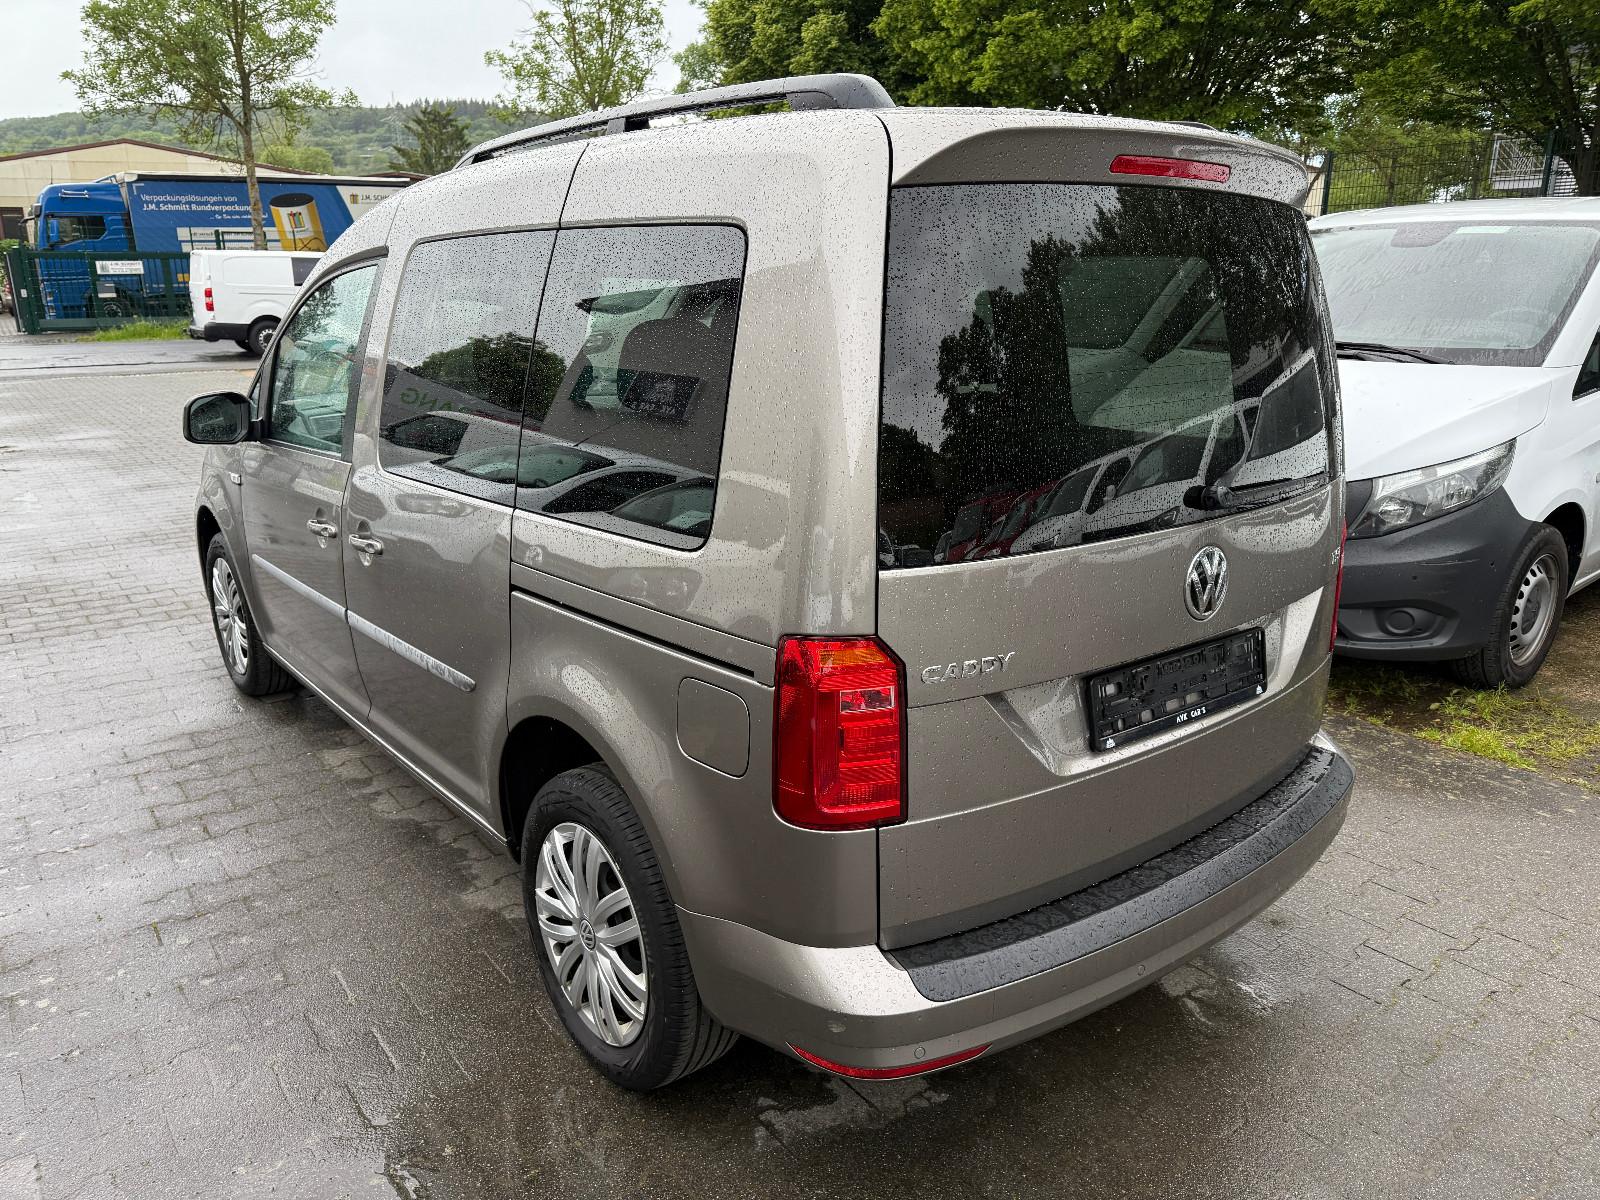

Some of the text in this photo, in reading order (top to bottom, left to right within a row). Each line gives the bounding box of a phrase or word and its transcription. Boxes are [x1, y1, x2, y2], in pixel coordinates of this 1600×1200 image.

[140, 194, 223, 203] Verpackungslösungen
[143, 203, 159, 211] J.M.
[160, 203, 190, 211] Schmitt
[920, 651, 1015, 684] CADDY
[1176, 712, 1188, 724] AYK
